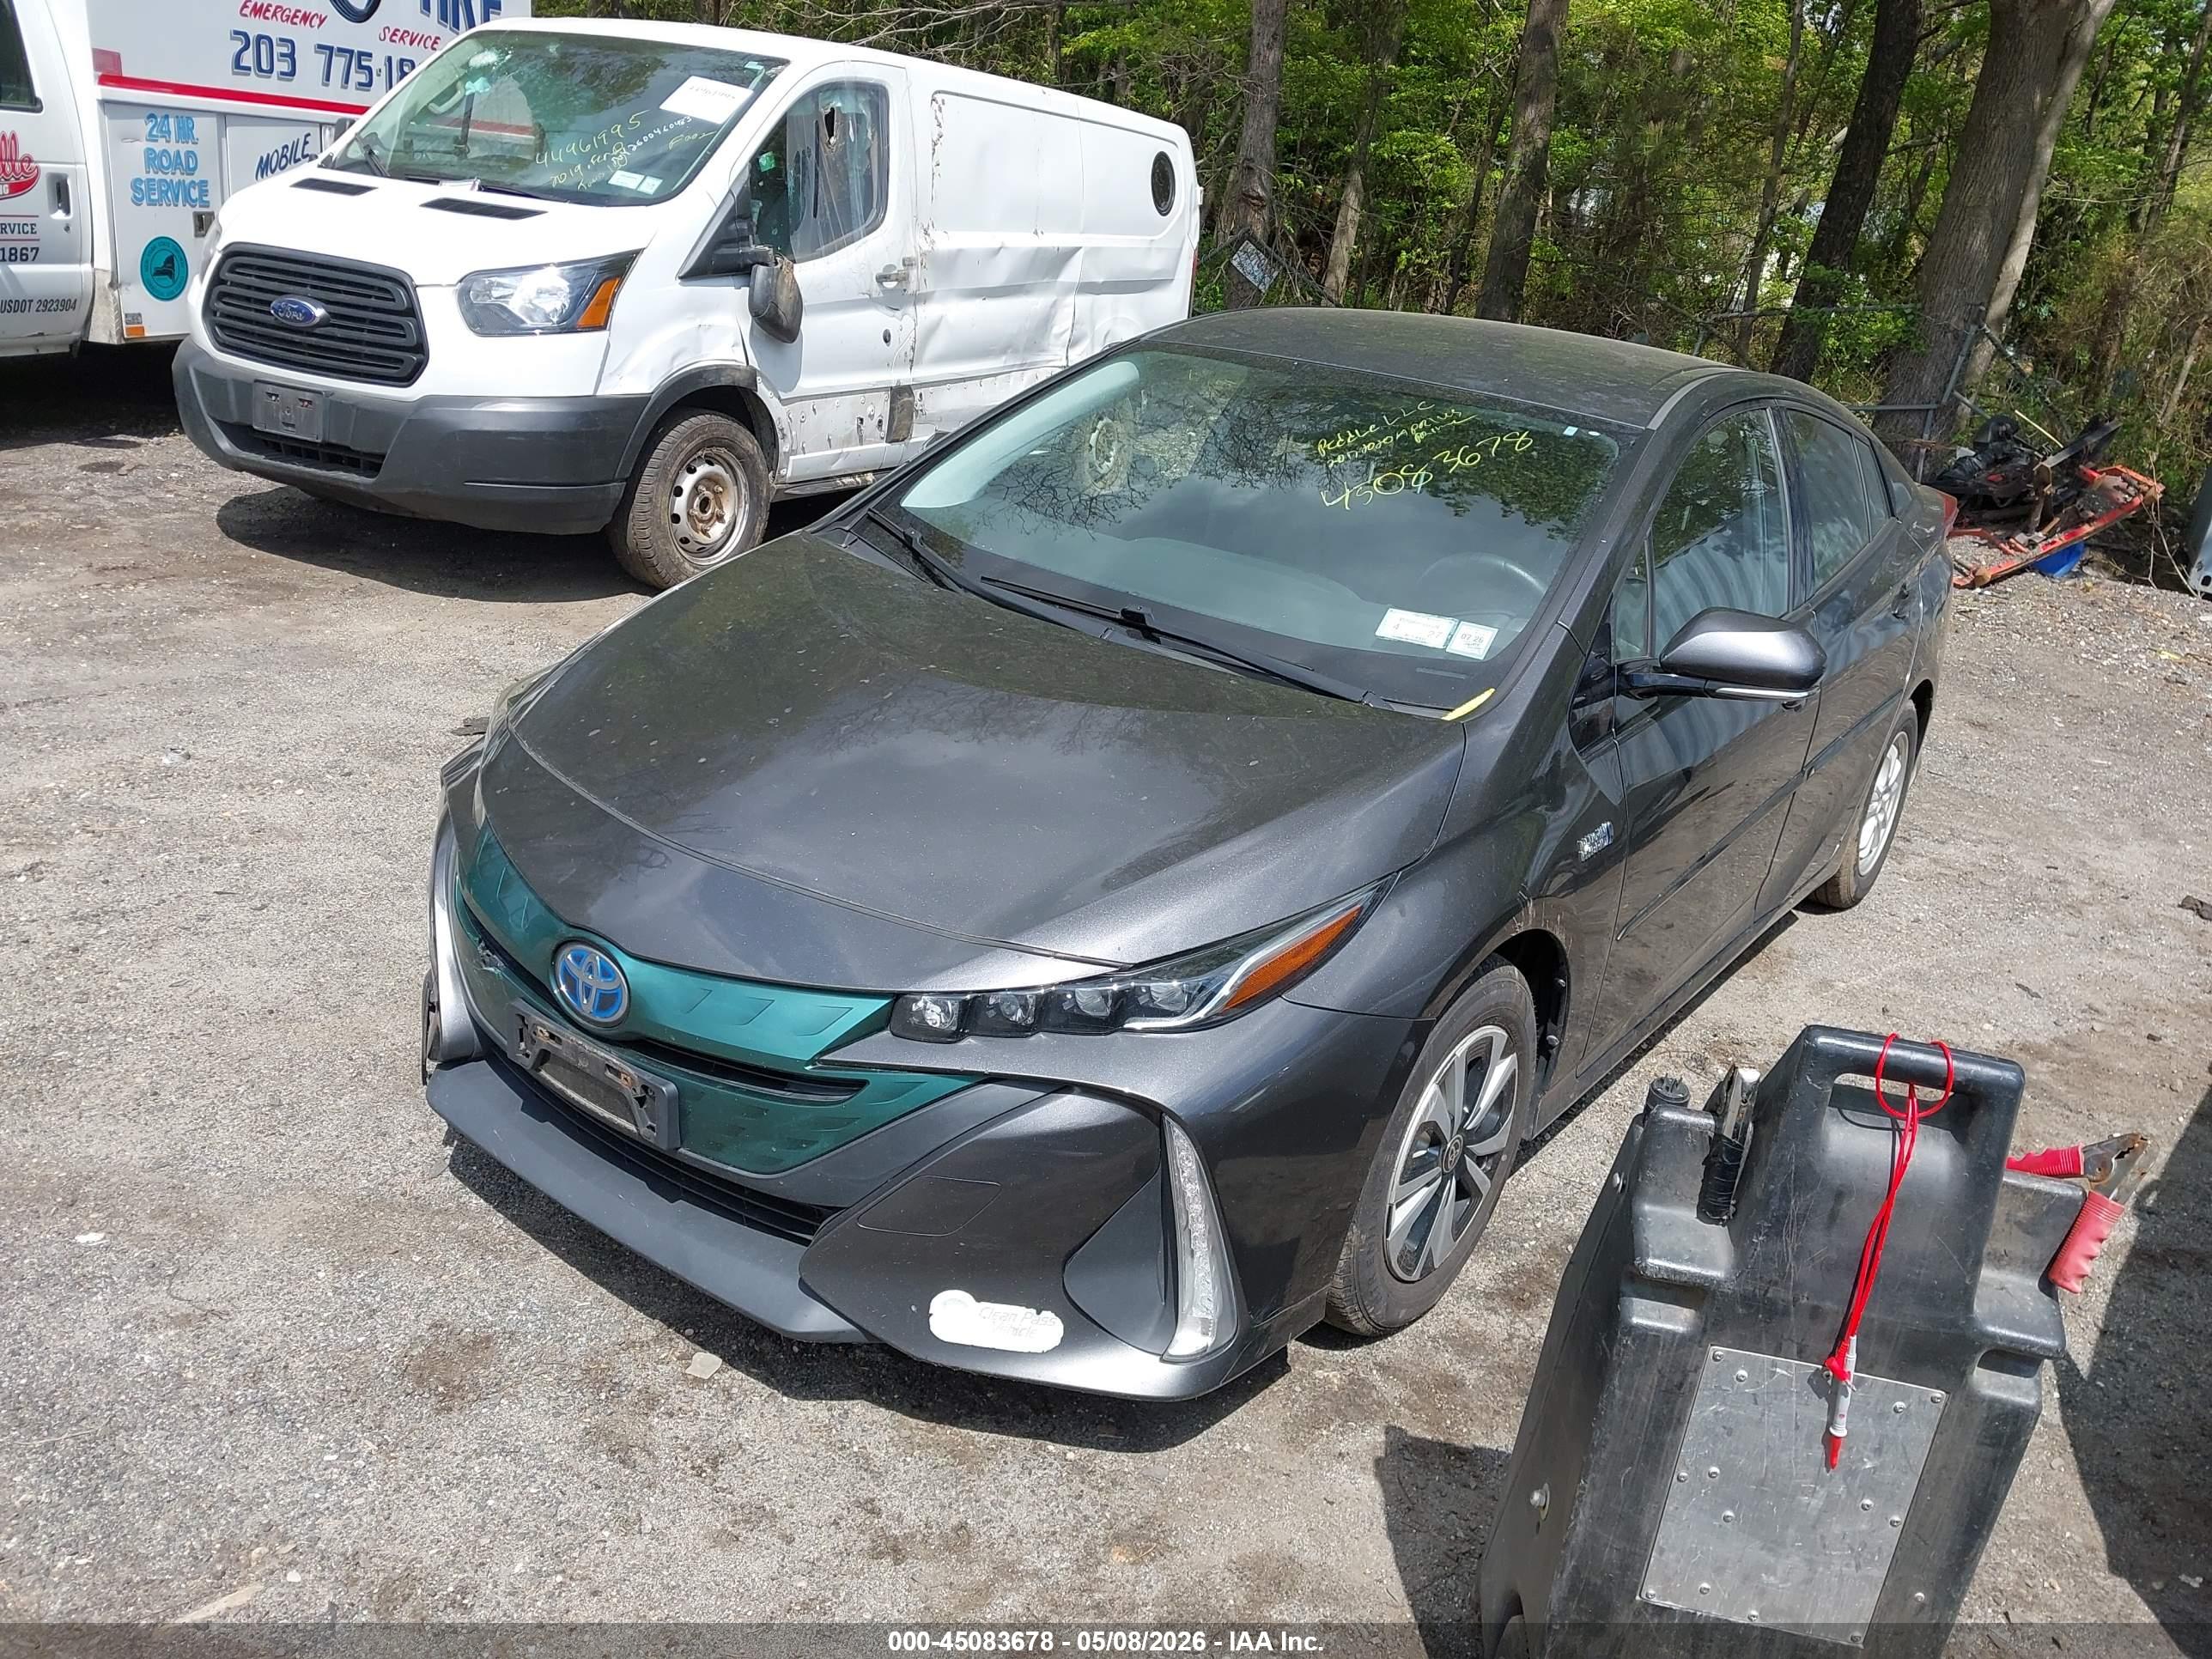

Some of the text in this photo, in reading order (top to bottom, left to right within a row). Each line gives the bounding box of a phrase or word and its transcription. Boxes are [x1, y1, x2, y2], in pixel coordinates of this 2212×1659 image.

[239, 0, 328, 28] EMERGENCY
[379, 26, 441, 52] SERVICE
[230, 29, 296, 81] 203
[144, 112, 172, 143] 24
[143, 147, 199, 176] ROAD
[255, 133, 311, 181] MOBILE
[131, 177, 210, 209] SERVICE
[0, 298, 77, 313] USDOT 2923904
[277, 301, 306, 321] Ford
[1320, 430, 1534, 511] 45083678
